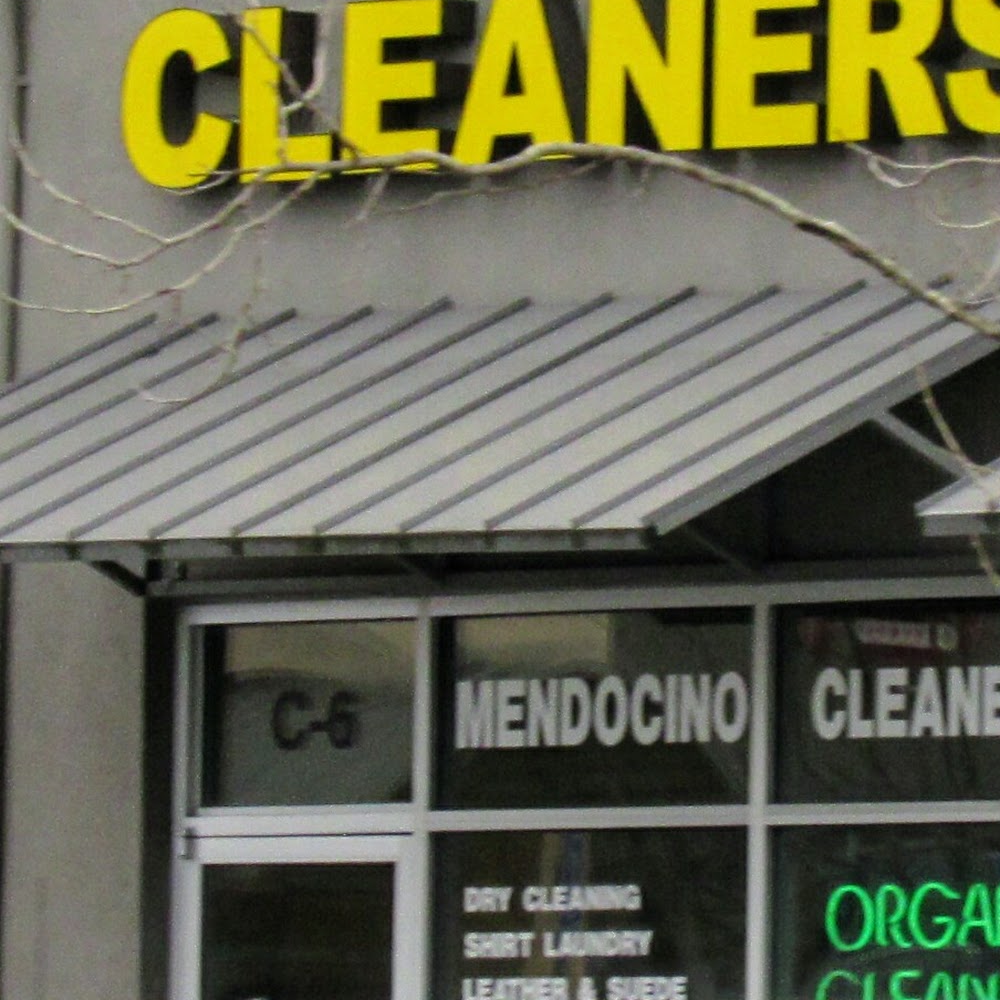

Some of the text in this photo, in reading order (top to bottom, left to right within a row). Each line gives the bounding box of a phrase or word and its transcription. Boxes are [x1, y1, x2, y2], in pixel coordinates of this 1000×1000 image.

[454, 671, 747, 749] MENDOCINO
[463, 884, 642, 913] DRY CLEANING
[463, 930, 653, 958] SHIRT LAUNDRY
[461, 978, 568, 1000] LEATHER
[605, 976, 689, 1000] SUEDE
